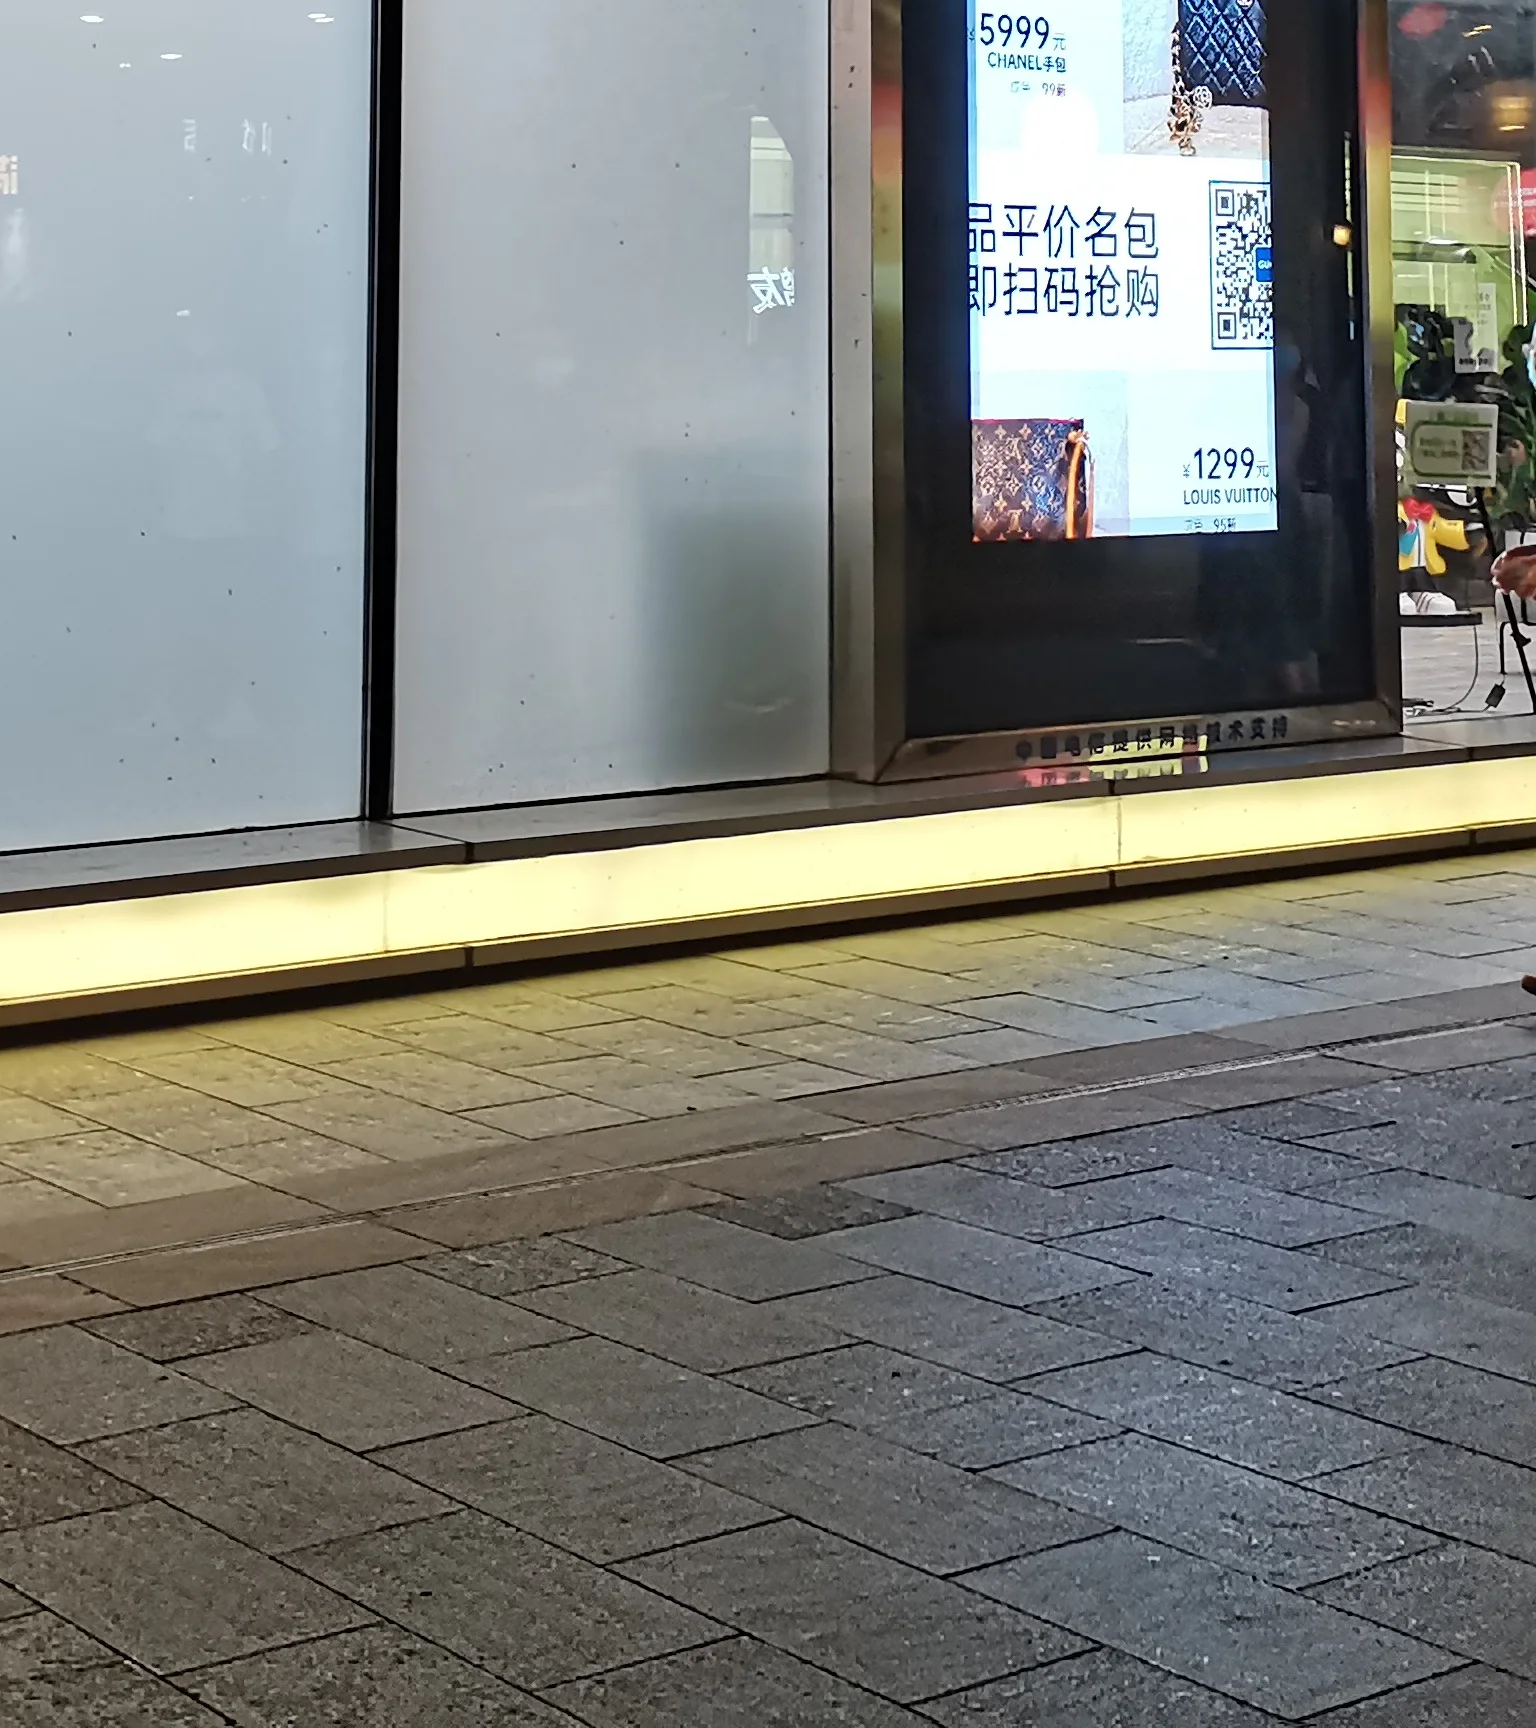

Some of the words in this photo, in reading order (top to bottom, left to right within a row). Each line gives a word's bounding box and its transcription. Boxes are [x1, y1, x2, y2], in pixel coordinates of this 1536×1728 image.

[968, 202, 1159, 258] 品平价名包
[968, 263, 1159, 318] 即扫码抢购
[1184, 489, 1221, 505] LOUIS
[1224, 487, 1278, 503] VUITTON
